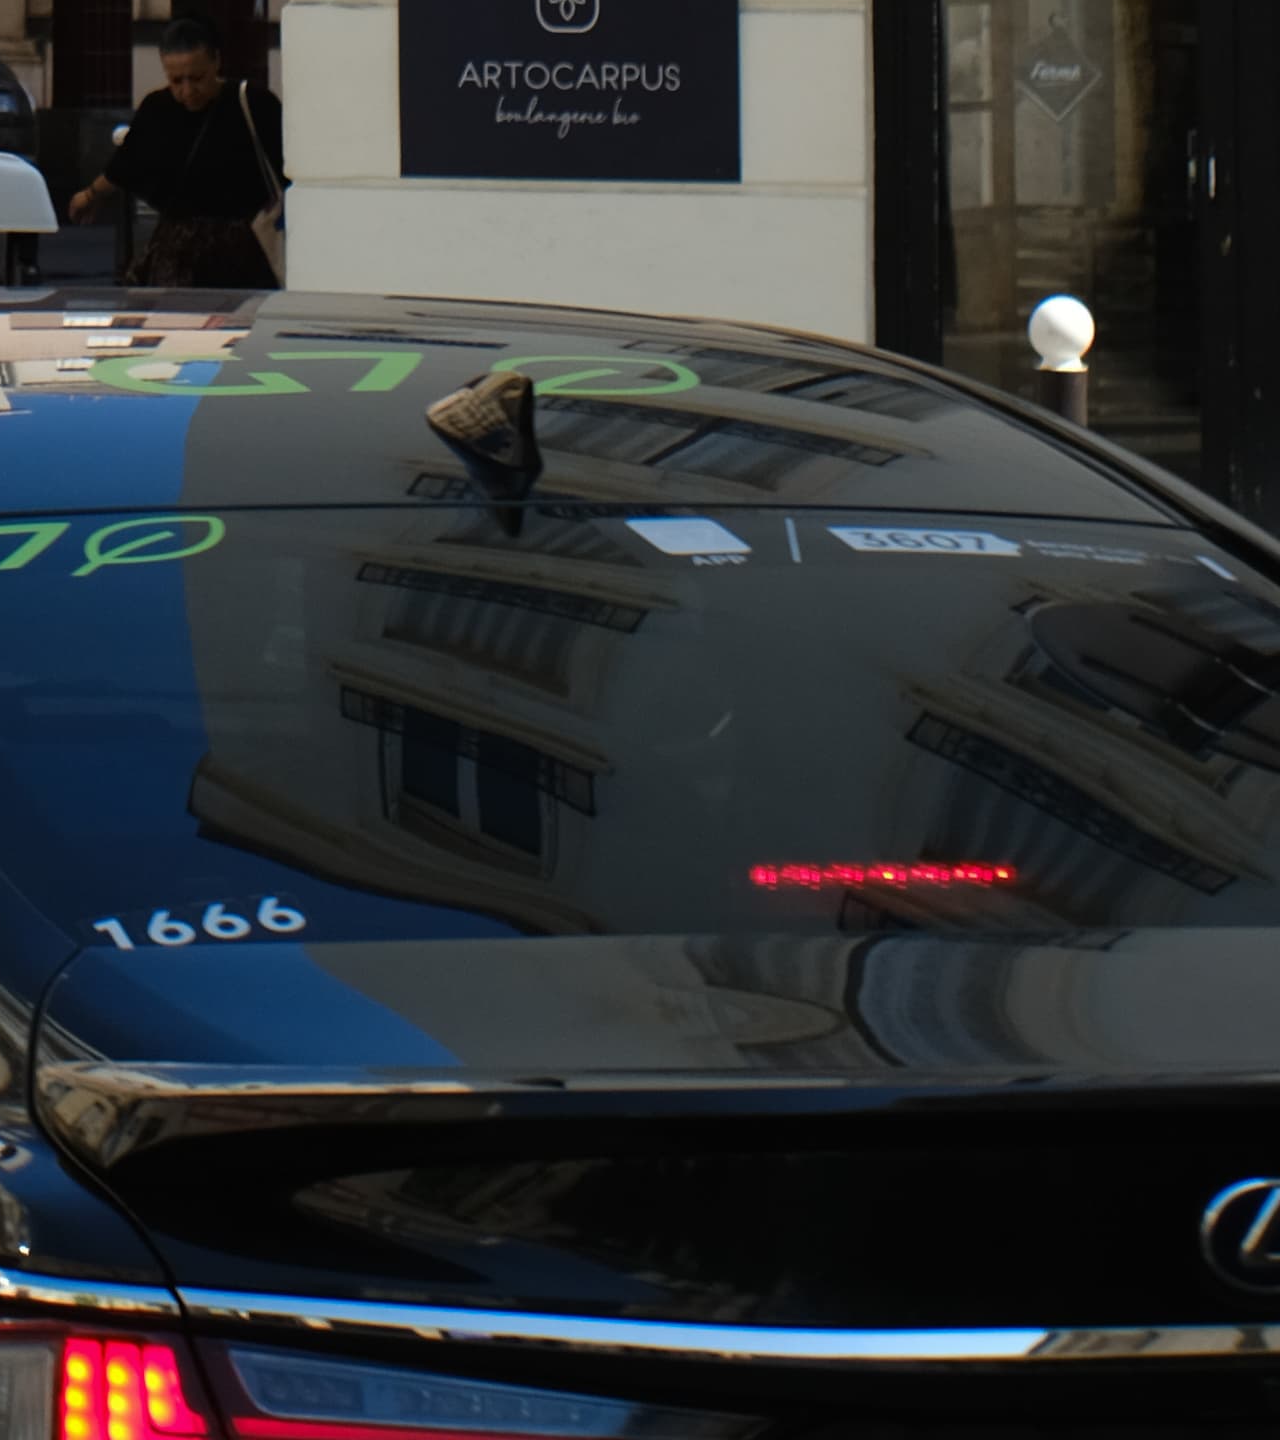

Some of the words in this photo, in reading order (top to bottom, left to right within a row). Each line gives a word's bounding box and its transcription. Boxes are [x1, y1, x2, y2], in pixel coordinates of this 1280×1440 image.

[457, 60, 681, 92] ARTOCARPUS
[494, 95, 607, 140] boulangerie
[612, 97, 642, 126] bio
[856, 530, 988, 552] 3607
[91, 894, 308, 953] 1666
